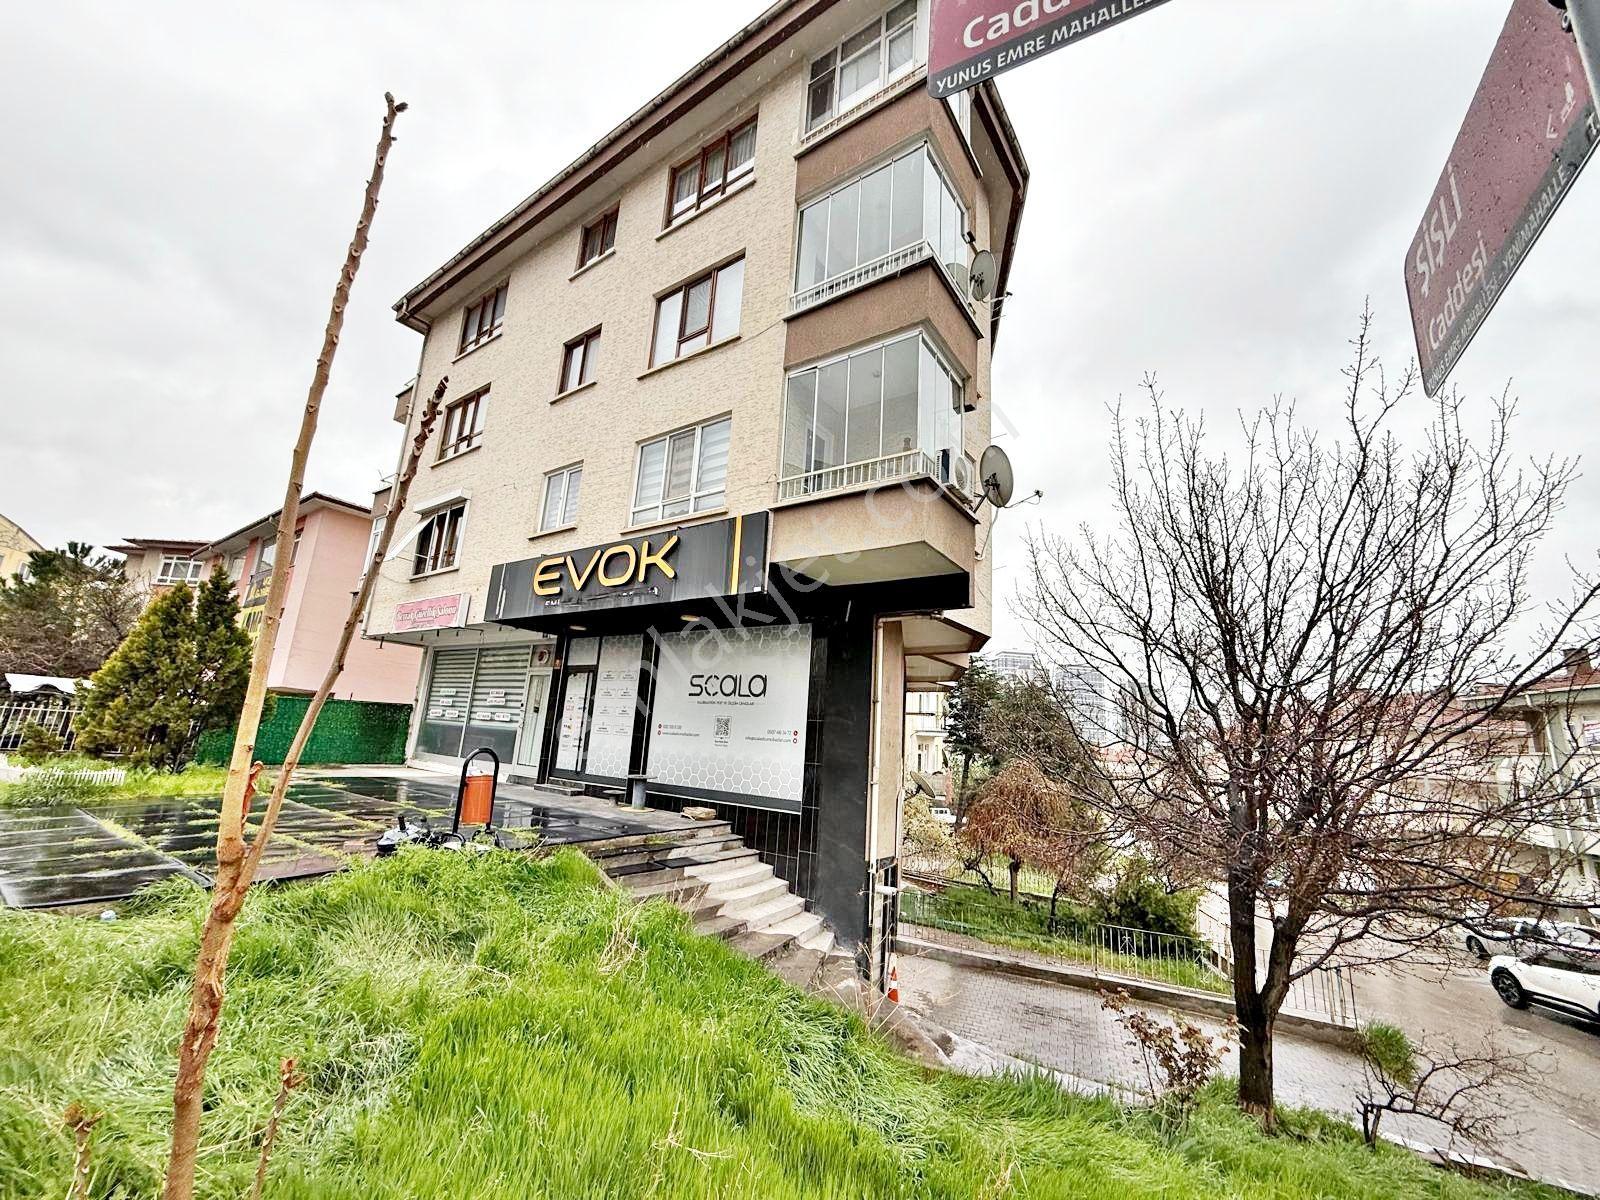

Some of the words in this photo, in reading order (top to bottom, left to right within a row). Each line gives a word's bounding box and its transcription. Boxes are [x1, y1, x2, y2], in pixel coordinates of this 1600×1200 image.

[963, 0, 1072, 48] Cad
[936, 59, 992, 92] YUNUS
[997, 35, 1046, 68] EMRE
[1428, 230, 1488, 350] Caddesi
[533, 535, 679, 596] EVOK
